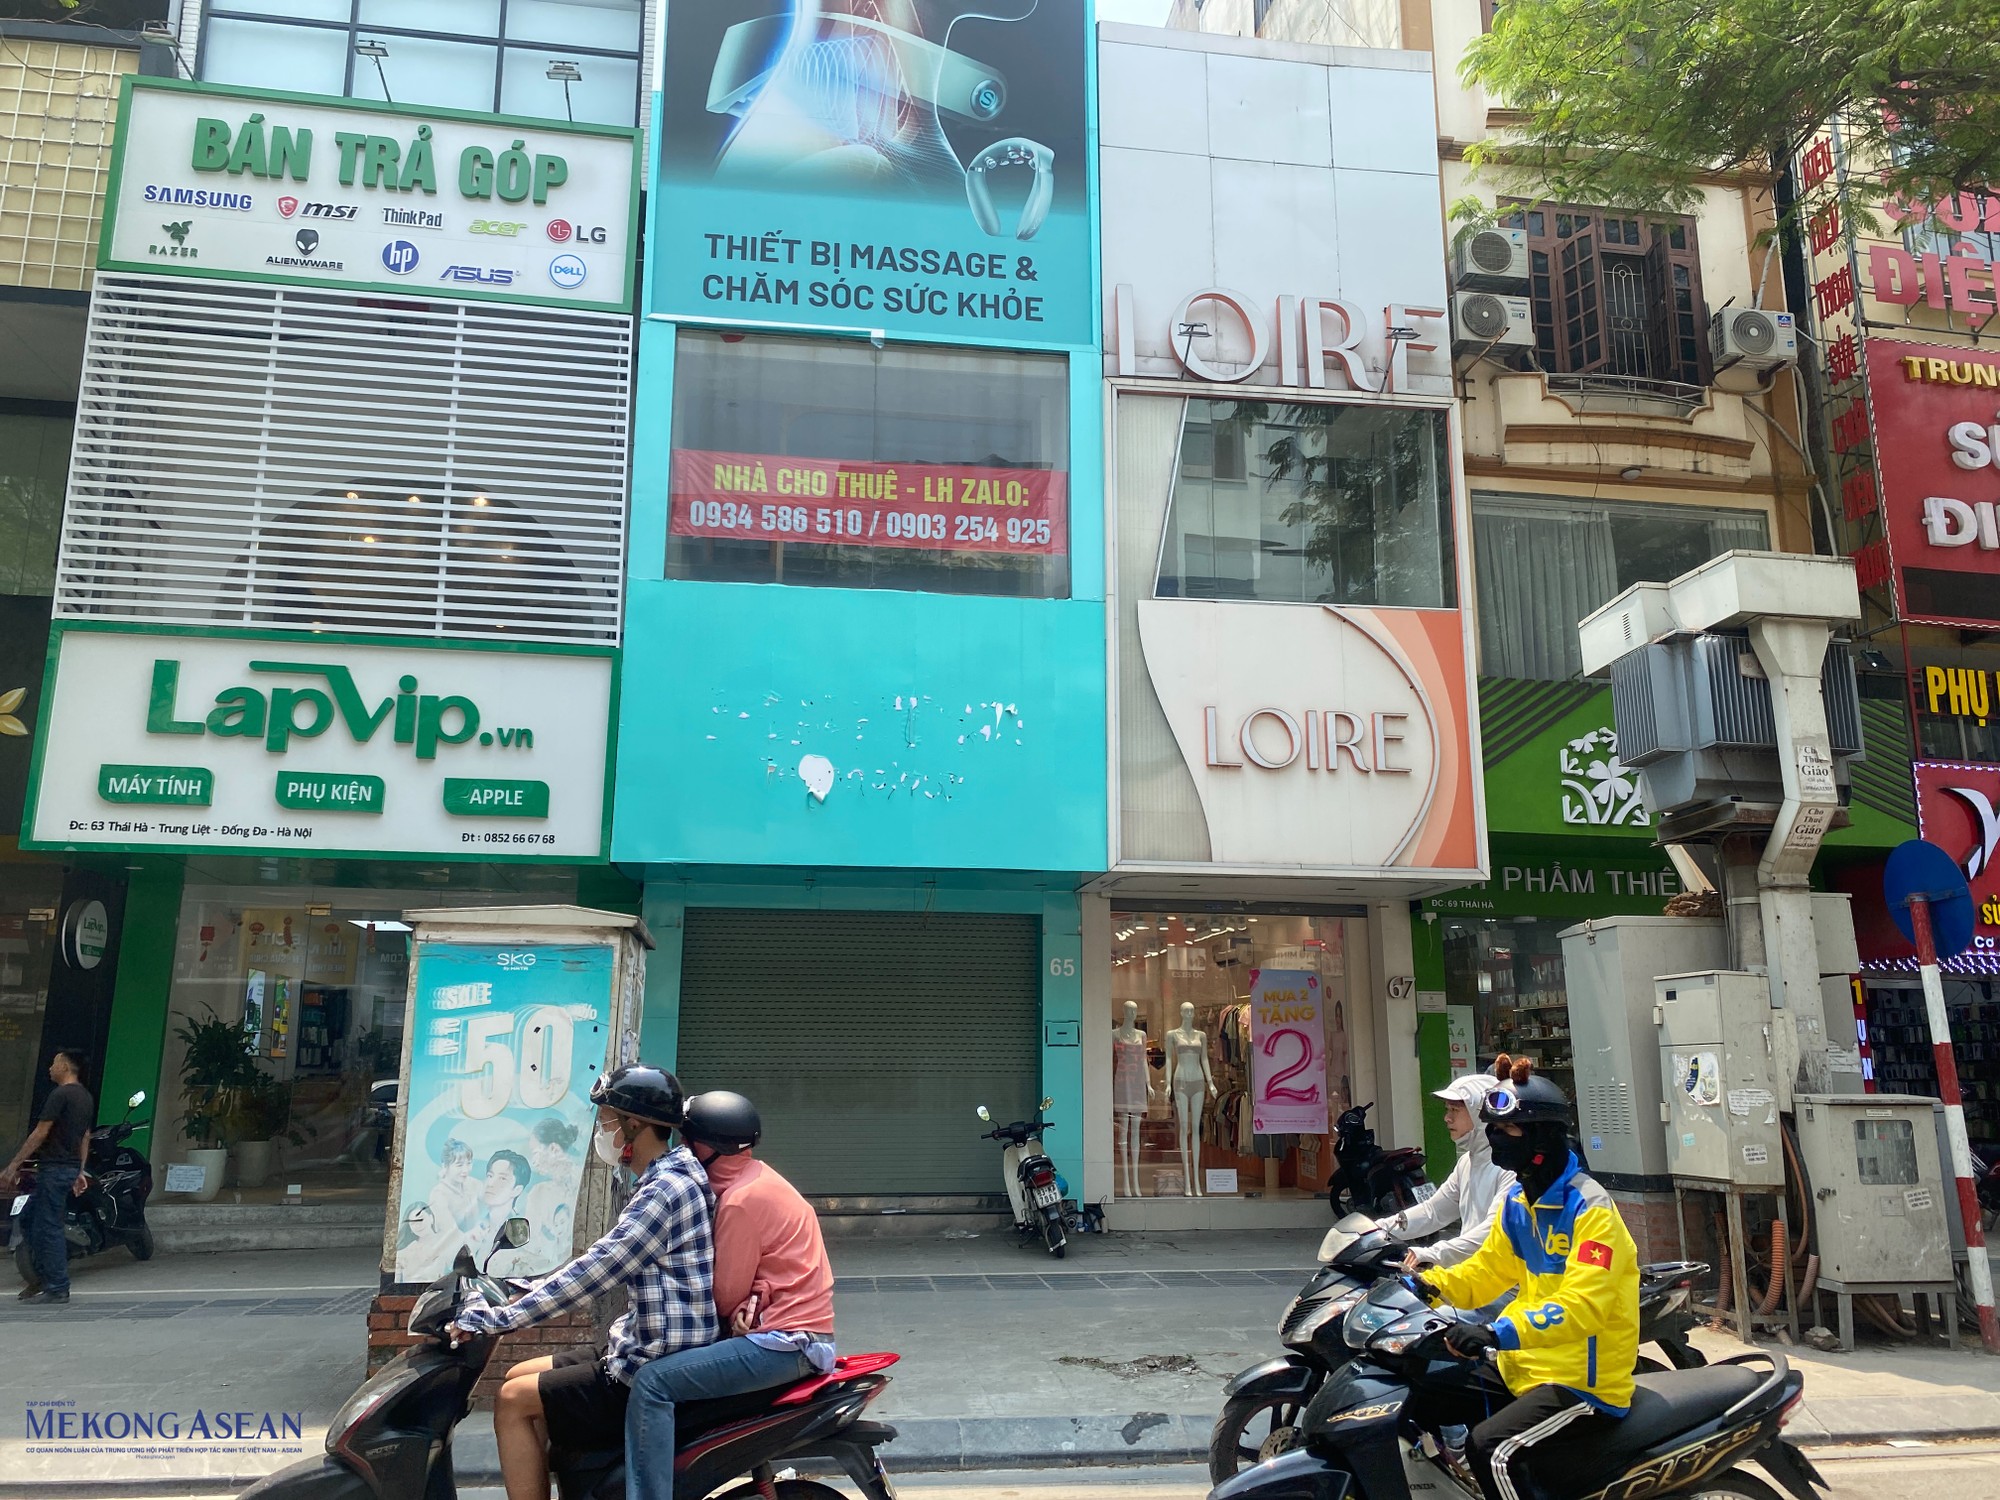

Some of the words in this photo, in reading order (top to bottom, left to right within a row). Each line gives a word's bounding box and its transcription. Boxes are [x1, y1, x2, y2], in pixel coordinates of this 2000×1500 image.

[192, 113, 313, 182] BÁN
[335, 124, 437, 193] TRẢ
[459, 140, 568, 205] GÓP
[143, 184, 253, 211] SAMSUNG
[301, 201, 360, 221] msi
[383, 207, 443, 228] ThinkPad
[468, 219, 527, 237] acer
[576, 225, 606, 243] LG
[149, 245, 198, 258] RAZER
[266, 256, 344, 270] ALIENWWARE
[389, 241, 413, 273] hp
[704, 229, 801, 264] THIẾT
[810, 241, 840, 274] BỊ
[850, 245, 1007, 280] MASSAGE
[1015, 256, 1039, 282] &
[439, 266, 514, 285] ASUS
[554, 265, 582, 276] DELL
[1868, 242, 2000, 328] ĐIỆ
[702, 272, 799, 306] CHĂM
[808, 277, 874, 311] SÓC
[883, 283, 948, 317] SỨC
[957, 288, 1044, 322] KHỎE
[1115, 284, 1446, 394] LOIRE
[1904, 356, 2000, 388] TRUN
[714, 461, 768, 493] NHÀ
[776, 468, 828, 497] CHO
[835, 469, 898, 500] THUÊ
[924, 476, 954, 504] LH
[961, 478, 1030, 507] ZALO:
[689, 500, 753, 530] 0934
[761, 507, 808, 533] 586
[816, 509, 862, 536] 510
[869, 510, 880, 537] /
[887, 512, 946, 540] 0903
[954, 516, 998, 542] 254
[1007, 519, 1050, 545] 925
[1922, 497, 2000, 550] ĐI
[1925, 665, 1990, 727] PHỤ
[1204, 705, 1412, 774] LOIRE
[1804, 746, 1818, 755] Ch
[1801, 764, 1829, 777] Giáo
[108, 772, 153, 796] MÁY
[157, 773, 202, 796] TÍNH
[287, 781, 323, 804] PHỤ
[324, 782, 372, 805] KIỆN
[469, 788, 524, 805] APPLE
[69, 820, 88, 831] Đc:
[91, 821, 104, 831] 63
[108, 821, 131, 832] Thái
[134, 822, 148, 833] Hà
[158, 824, 189, 836] Trung
[192, 824, 211, 836] Liệt
[221, 825, 250, 838] Đống
[253, 826, 267, 836] Đa
[277, 827, 291, 837] Hà
[294, 828, 312, 838] Nội
[484, 833, 510, 843] 0852
[512, 834, 526, 843] 66
[528, 834, 540, 843] 67
[542, 834, 555, 844] 68
[1795, 824, 1822, 835] Giáo
[1503, 860, 1595, 893] PHẨM
[1605, 866, 1687, 896] THIÊ
[1447, 900, 1458, 908] 69
[1482, 900, 1495, 909] HÀ
[497, 953, 536, 966] SKG
[1049, 958, 1075, 977] 65
[434, 982, 492, 1010] SALE
[1263, 990, 1297, 1003] MUA
[1301, 989, 1309, 1000] 2
[1388, 977, 1416, 999] 67
[1258, 1004, 1316, 1027] TẶNG
[1263, 1028, 1320, 1103] 2
[1545, 1225, 1570, 1256] be
